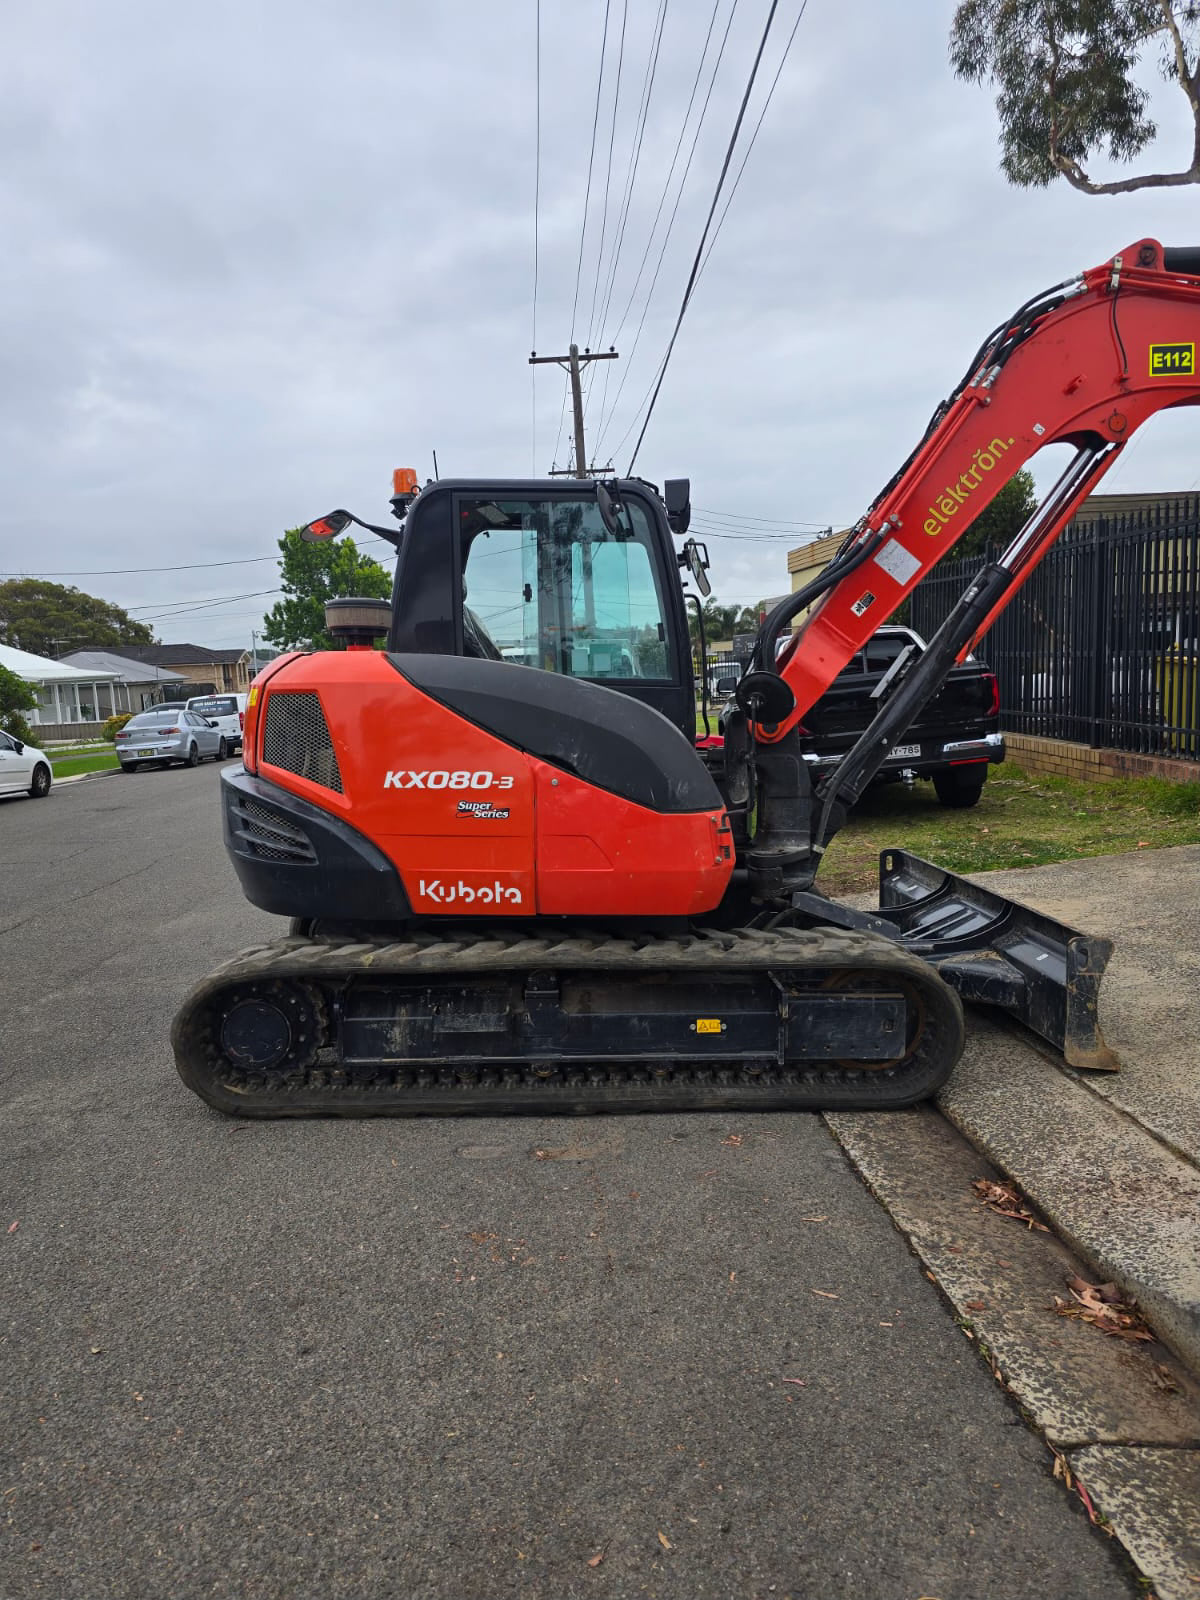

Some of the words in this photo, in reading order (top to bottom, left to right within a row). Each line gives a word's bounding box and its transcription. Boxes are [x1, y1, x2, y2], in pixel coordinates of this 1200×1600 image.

[1153, 351, 1192, 368] E112
[383, 770, 515, 789] KX080-3
[457, 801, 493, 812] Super
[473, 808, 509, 819] Series
[419, 879, 522, 904] Kubota
